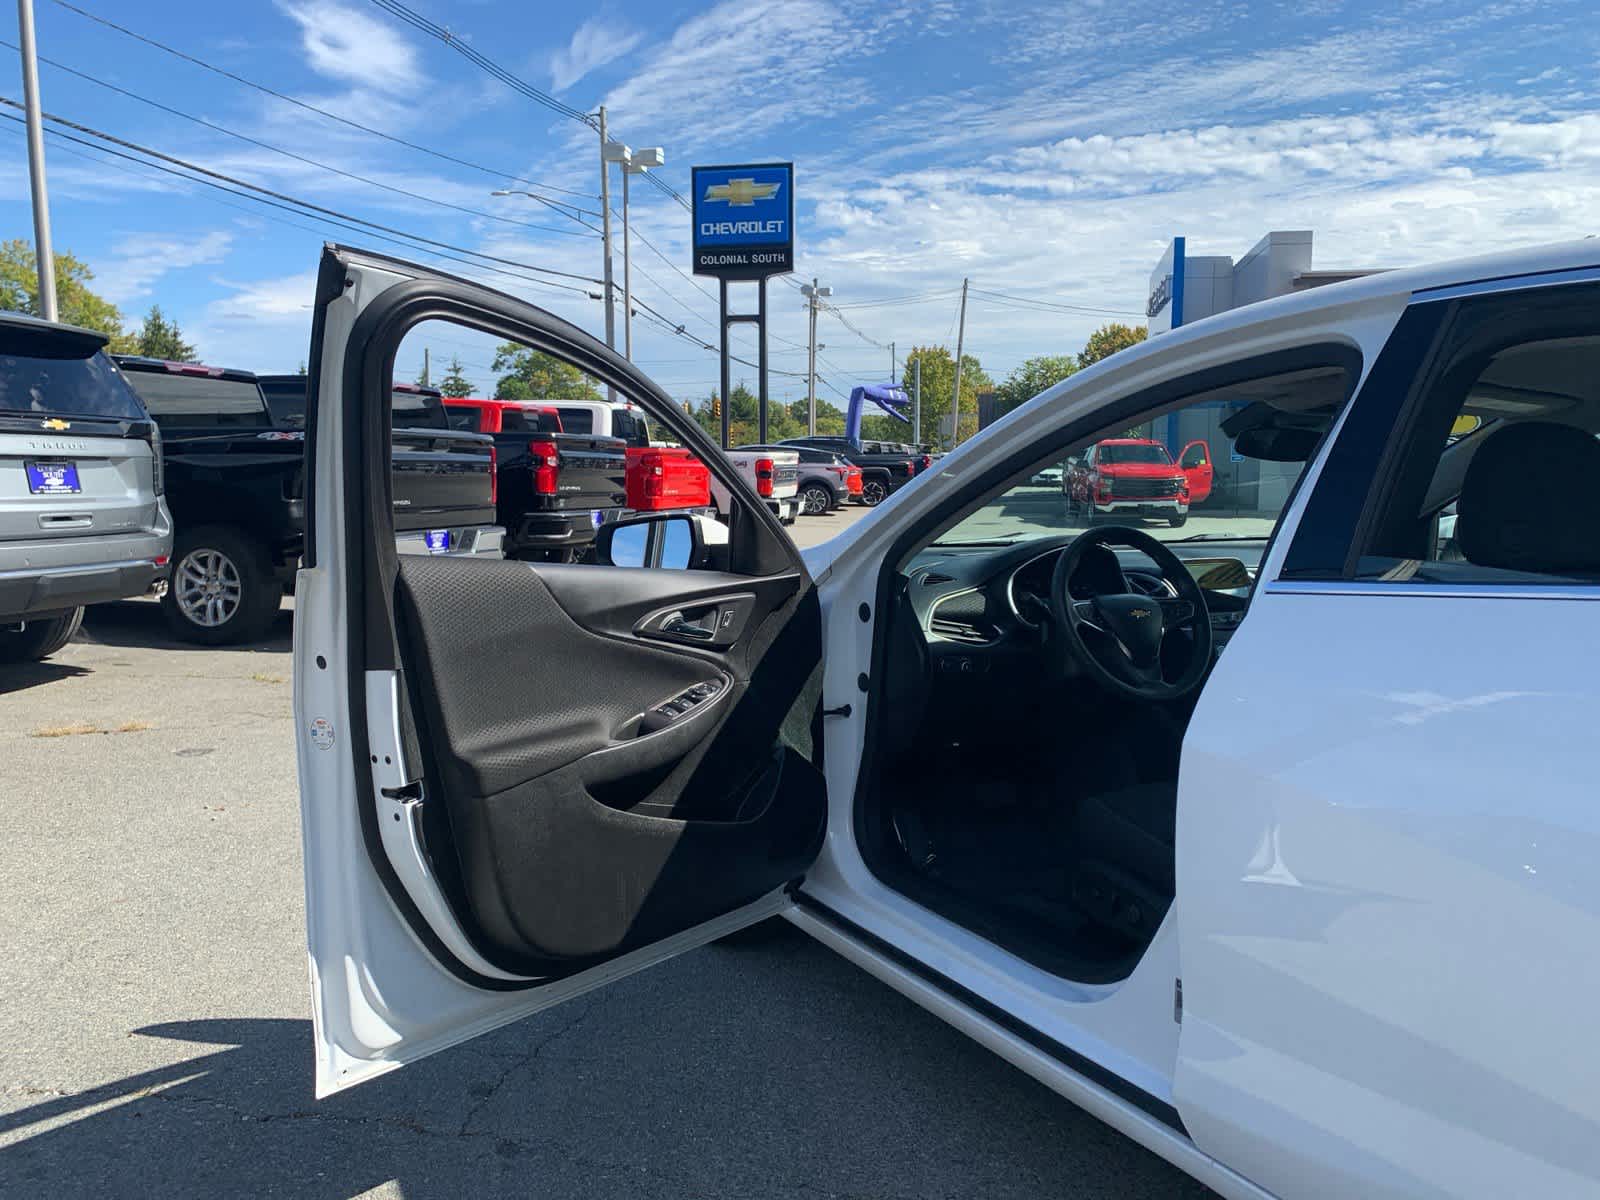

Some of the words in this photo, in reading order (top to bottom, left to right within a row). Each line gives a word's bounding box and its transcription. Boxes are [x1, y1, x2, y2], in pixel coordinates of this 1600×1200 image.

[701, 220, 784, 236] CHEVROLET
[700, 255, 748, 265] COLONIAL
[752, 253, 785, 263] SOUTH
